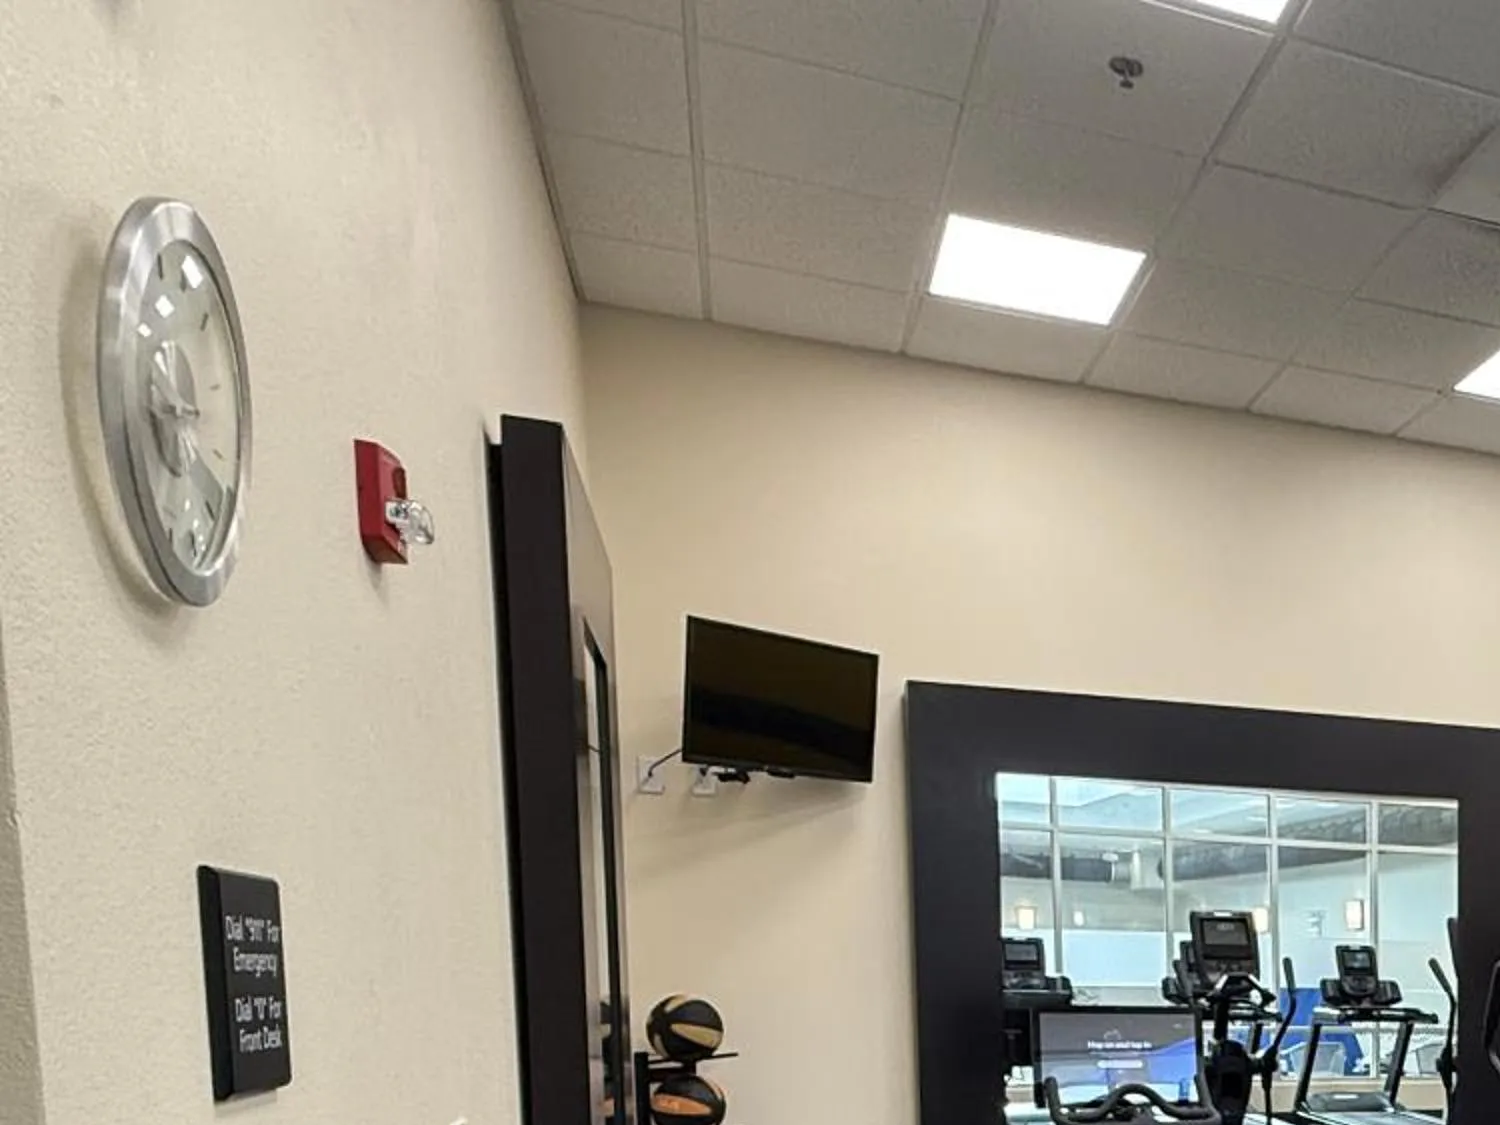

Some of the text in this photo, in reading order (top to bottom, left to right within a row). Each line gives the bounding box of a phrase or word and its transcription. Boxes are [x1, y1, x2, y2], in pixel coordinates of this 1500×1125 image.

[225, 914, 243, 941] Dial
[266, 919, 280, 943] For
[233, 946, 278, 978] Emergency
[234, 997, 252, 1023] Dial
[268, 996, 282, 1020] For
[239, 1024, 282, 1053] Front Desk
